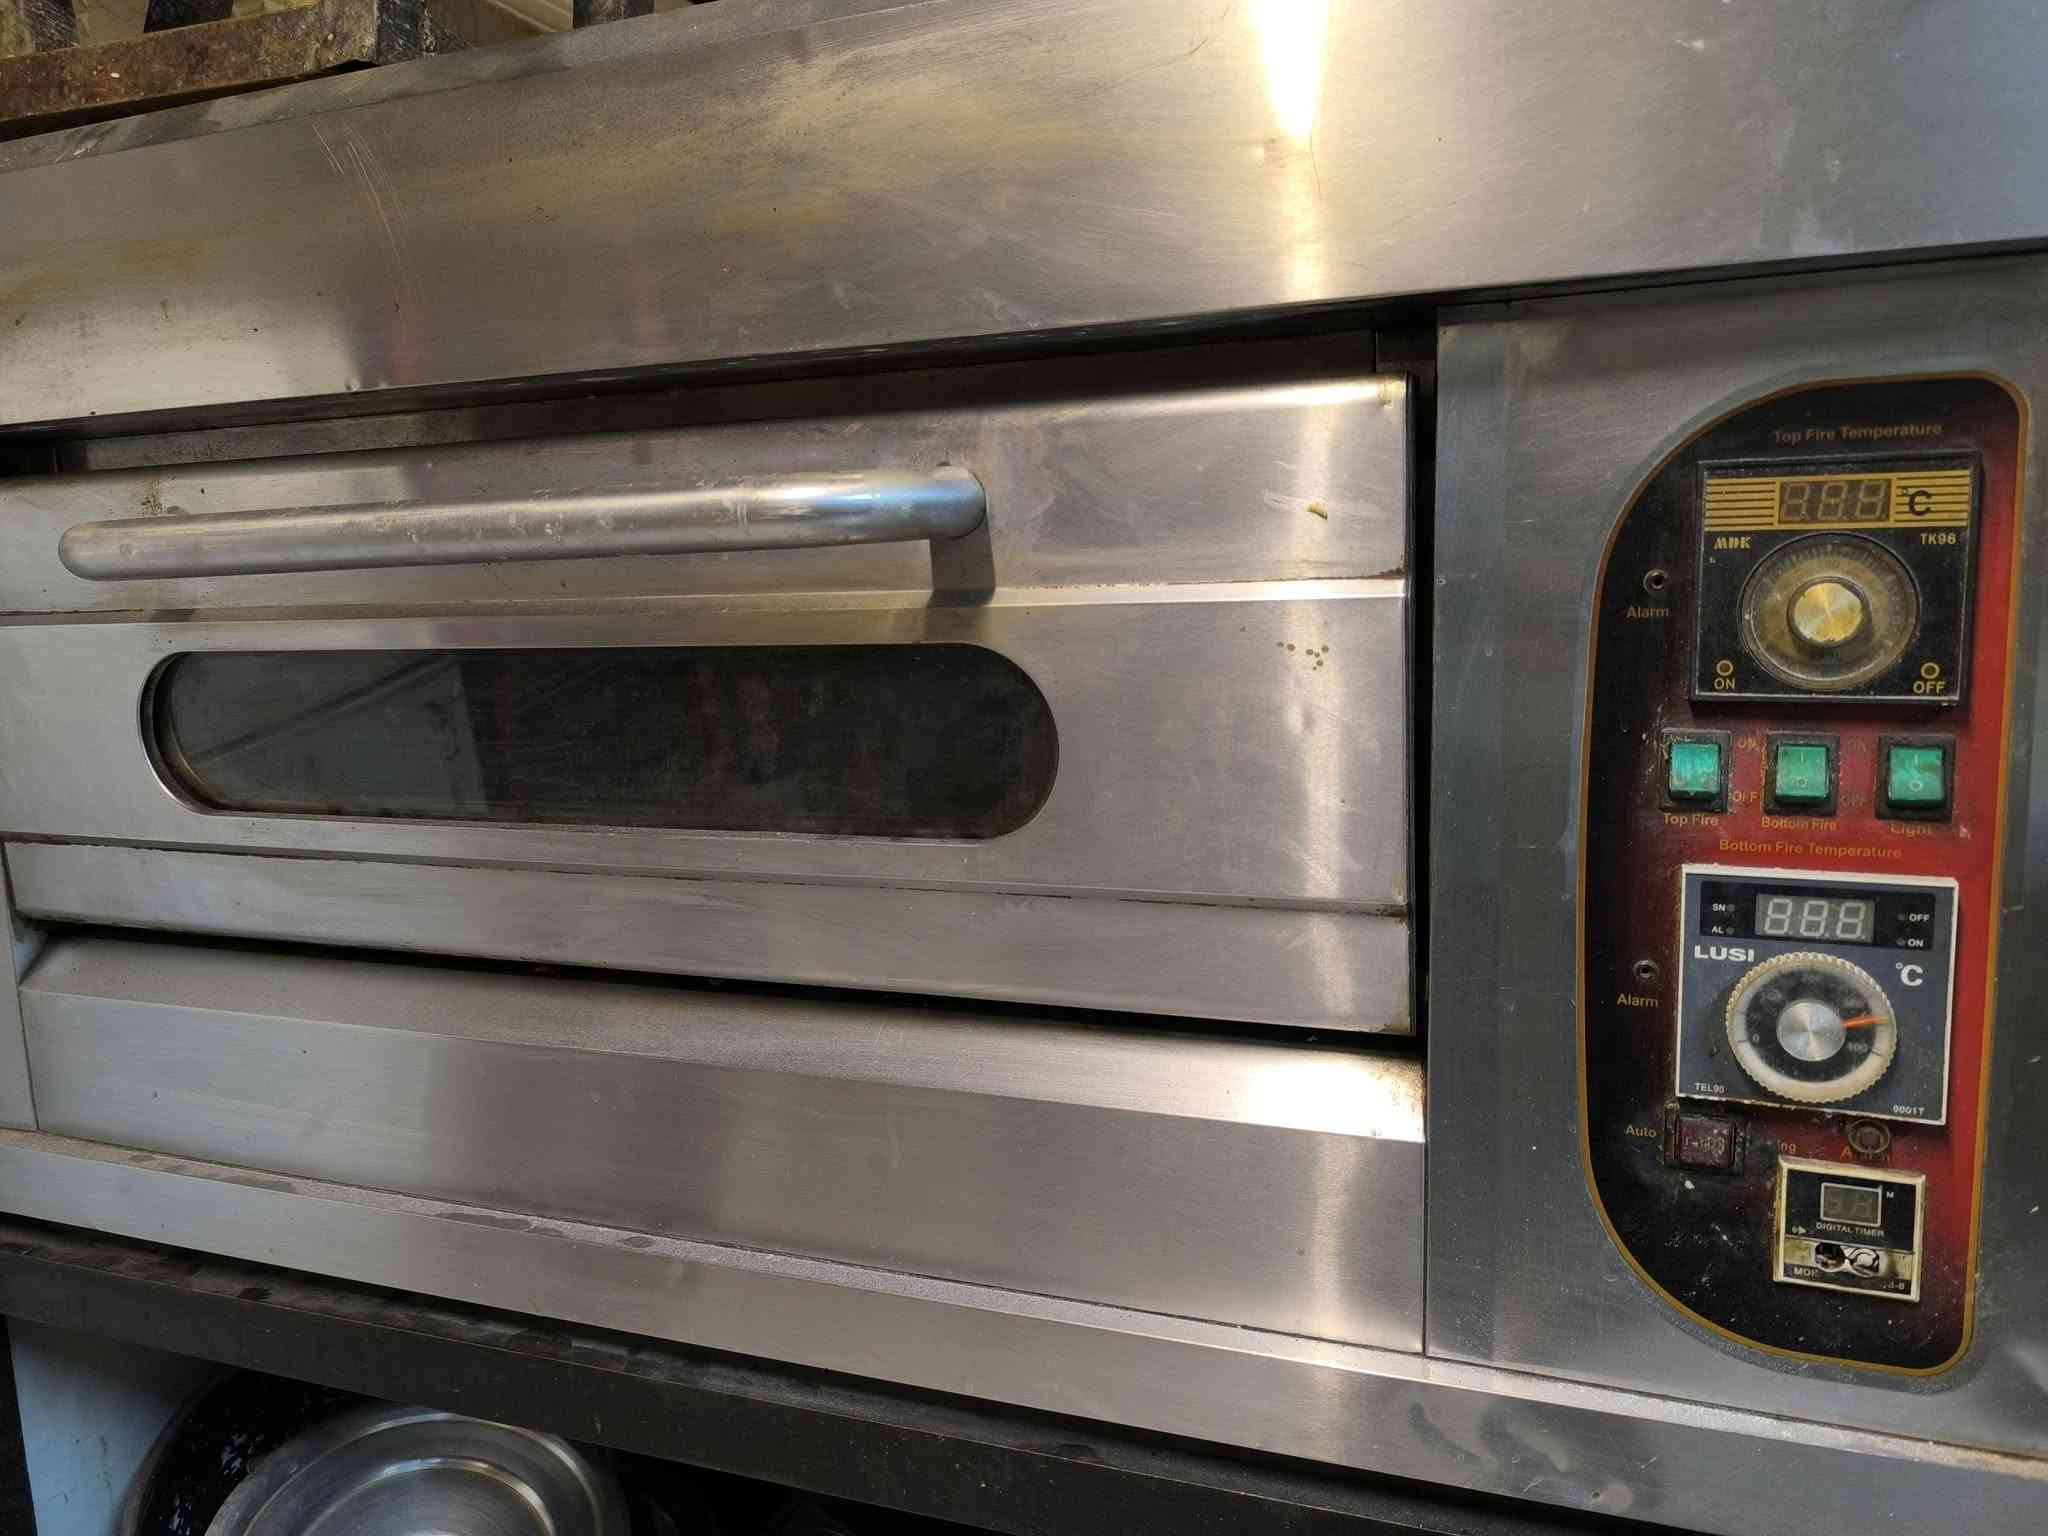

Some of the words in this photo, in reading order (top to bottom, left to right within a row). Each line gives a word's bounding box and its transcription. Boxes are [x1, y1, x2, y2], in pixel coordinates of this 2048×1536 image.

[1776, 430, 1801, 446] Top
[1806, 427, 1836, 440] Fire
[1840, 422, 1943, 441] Temperature
[1625, 605, 1670, 619] Alarm
[1713, 678, 1736, 690] ON
[1912, 680, 1946, 695] OFF
[1663, 813, 1688, 827] Top
[1692, 813, 1720, 827] Fire
[1760, 816, 1809, 830] Bottom
[1812, 819, 1838, 831] Fire
[1719, 839, 1772, 852] Bottom
[1775, 841, 1803, 854] Fire
[1807, 842, 1902, 859] Temperature
[1908, 913, 1930, 922] OFF
[1907, 938, 1924, 948] ON
[1694, 944, 1755, 962] LUSI
[1617, 994, 1658, 1007] Alarm
[1625, 1124, 1657, 1138] Auto
[1816, 1222, 1852, 1233] DIGITAL
[1855, 1226, 1884, 1236] TIMER
